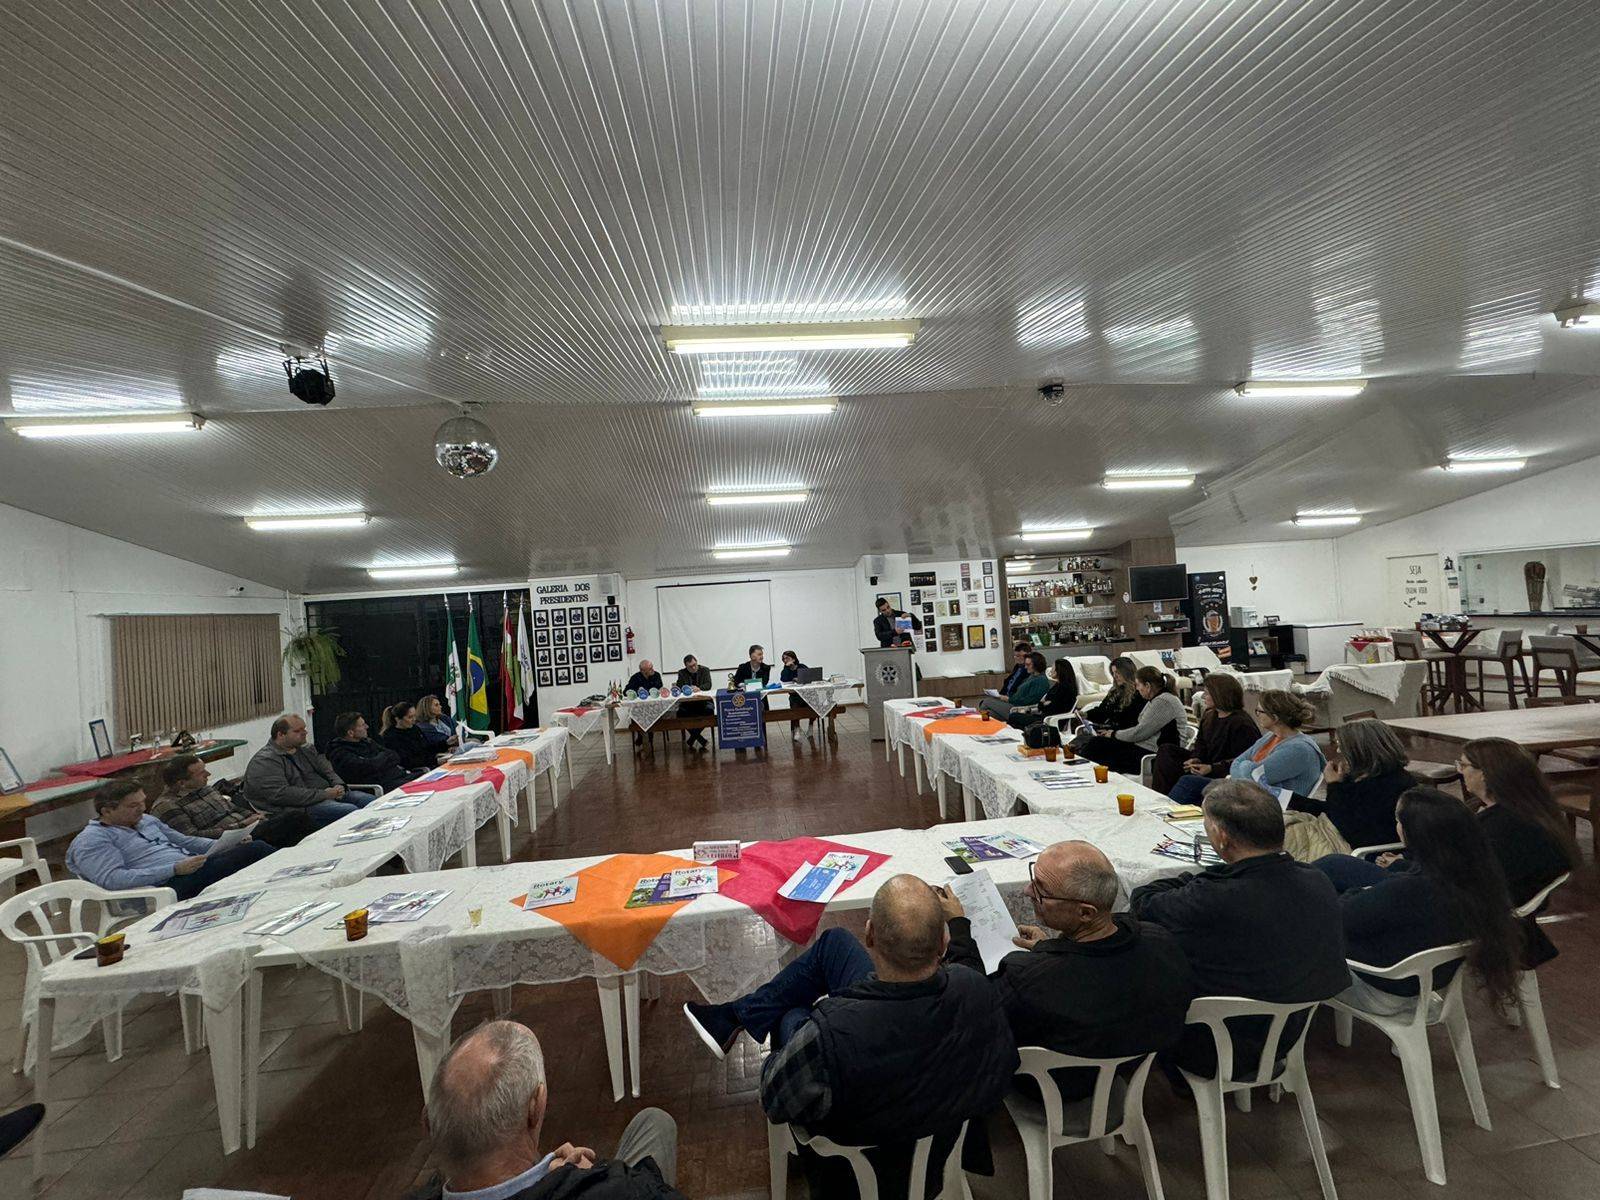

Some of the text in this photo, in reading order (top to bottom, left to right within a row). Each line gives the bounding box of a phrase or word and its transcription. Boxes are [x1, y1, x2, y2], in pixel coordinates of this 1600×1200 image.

[1409, 565, 1422, 575] SEJA
[536, 582, 591, 595] GALERIA DOS
[540, 593, 589, 605] PRESIDENTES
[675, 868, 704, 876] Rotary
[533, 880, 564, 889] Rotary
